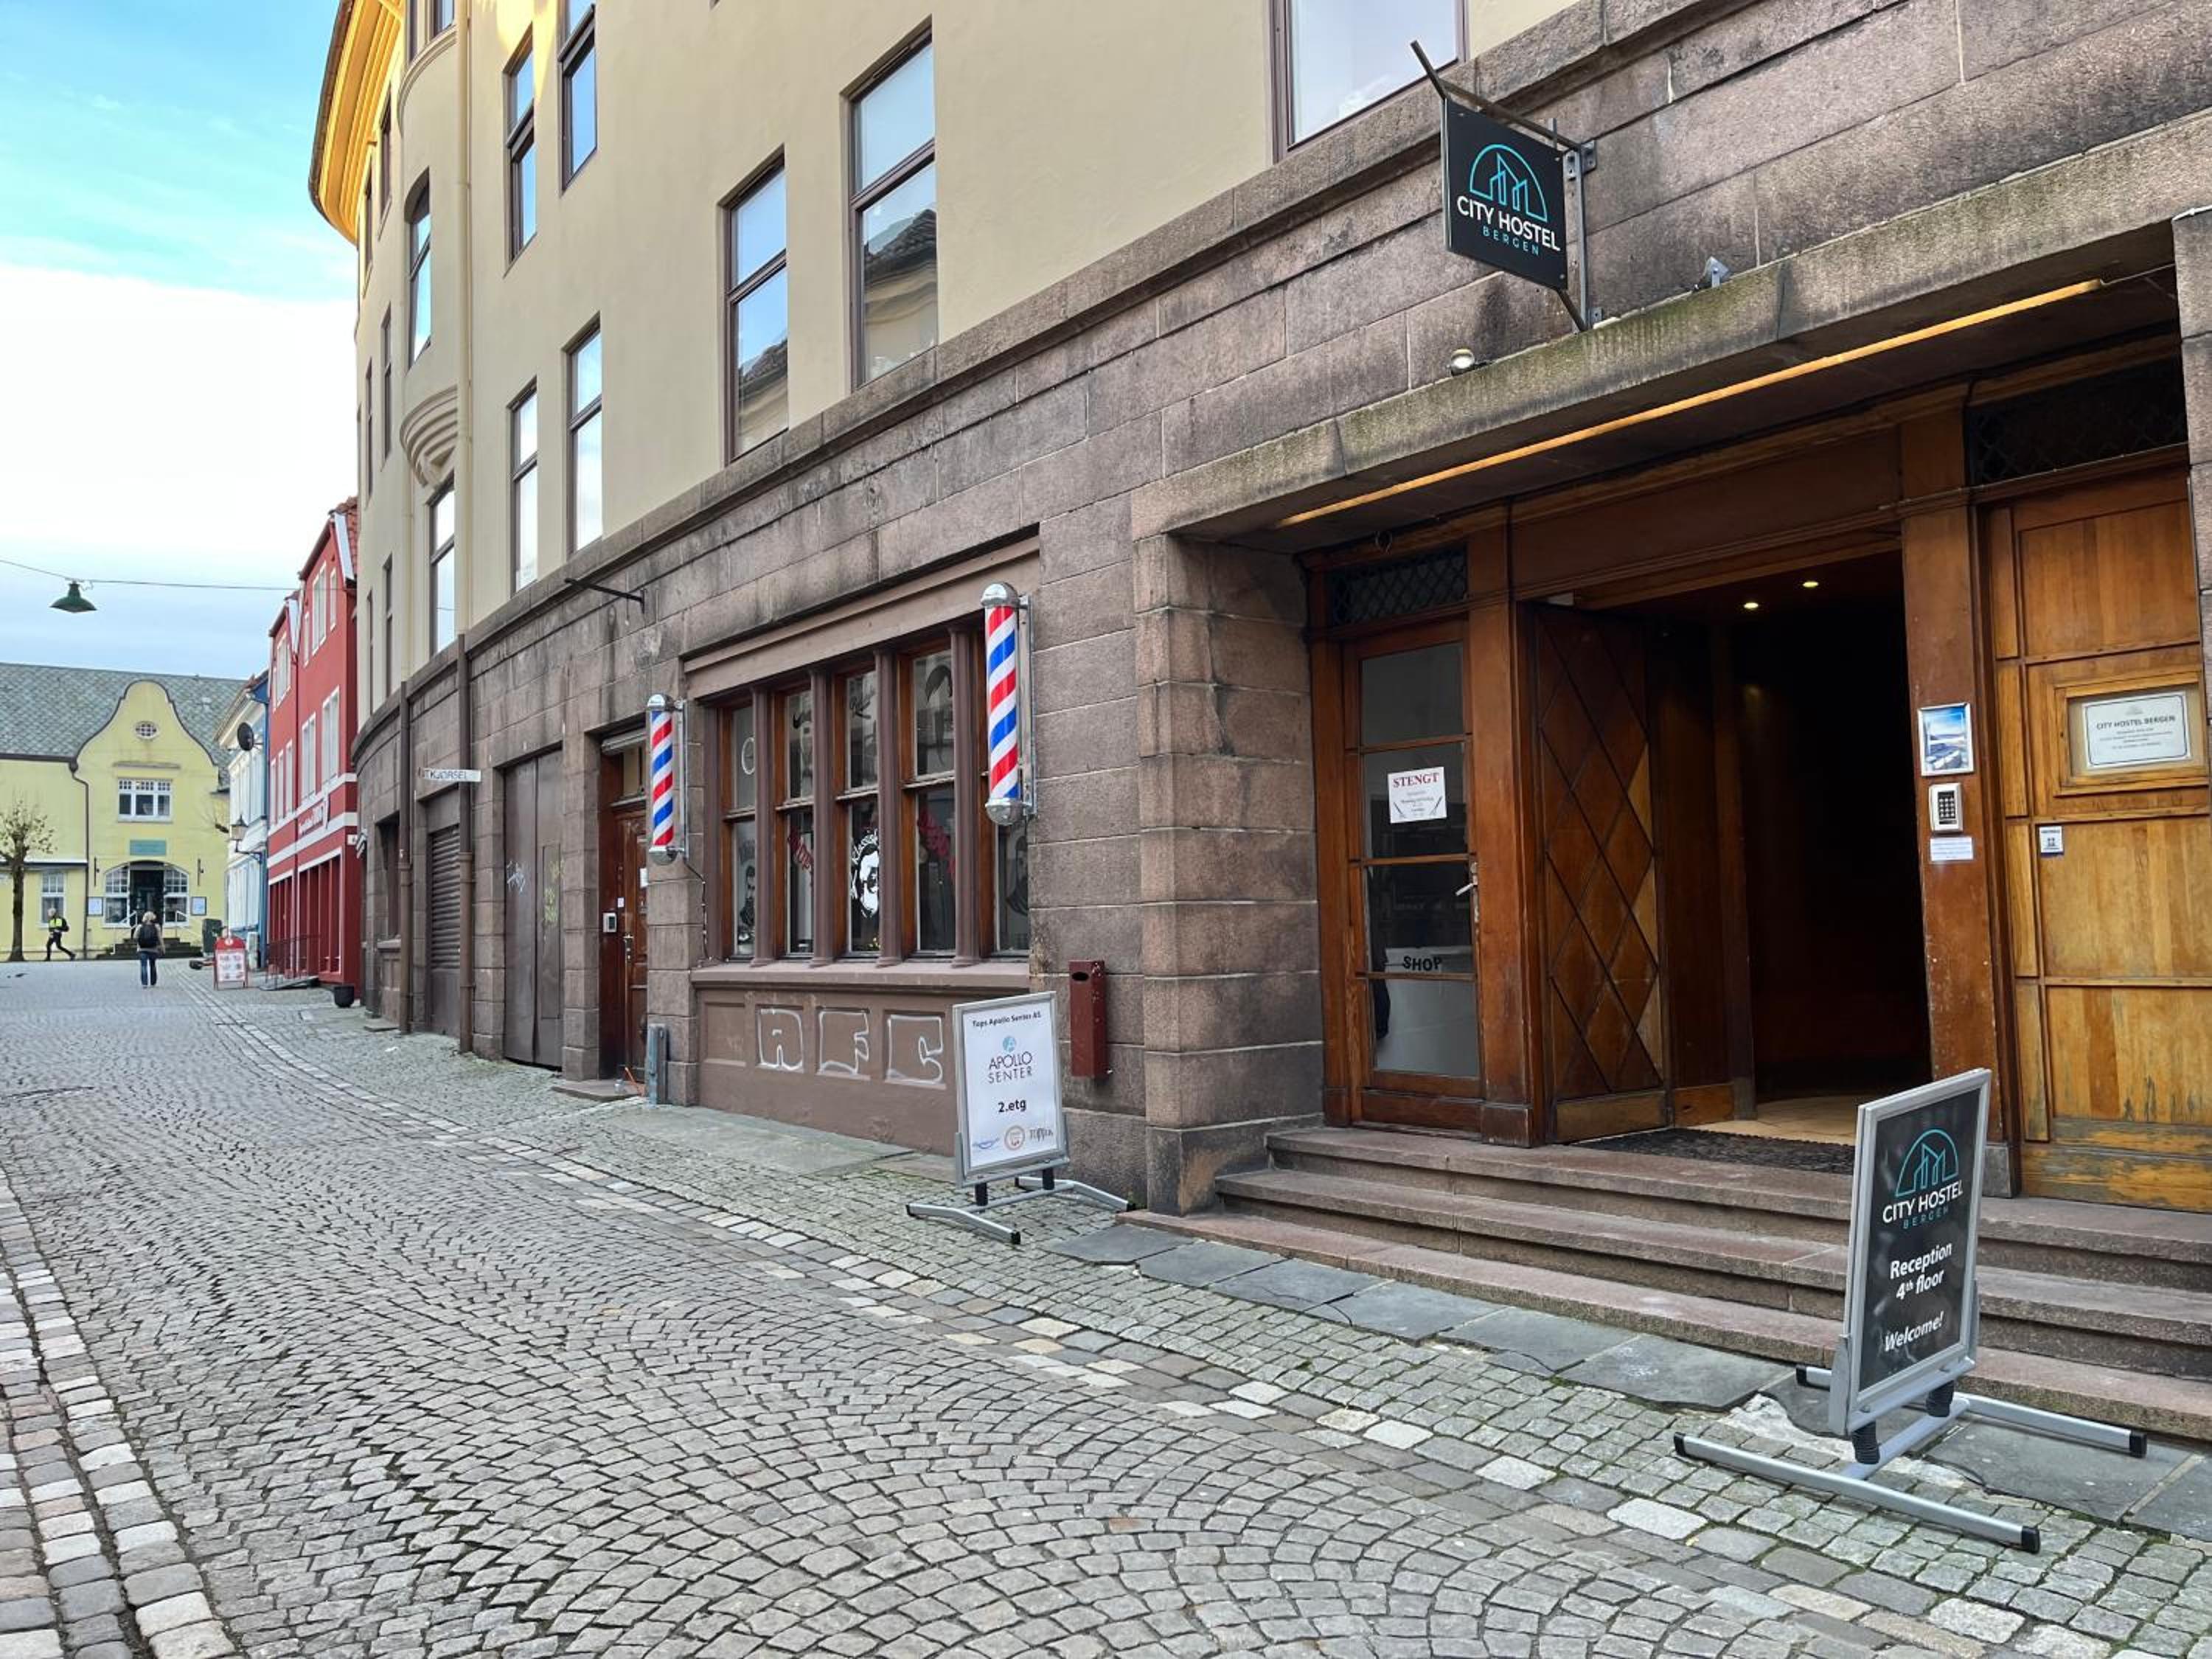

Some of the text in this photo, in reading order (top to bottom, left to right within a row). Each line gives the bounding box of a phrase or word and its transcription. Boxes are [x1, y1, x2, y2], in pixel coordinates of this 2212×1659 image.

[1456, 195, 1561, 251] CITY HOSTEL
[1483, 226, 1540, 257] BERGEN
[2096, 722, 2112, 730] CITY
[1393, 772, 1440, 788] STENGT
[1402, 955, 1441, 972] SHOP
[989, 1051, 1033, 1071] APOLLO
[988, 1065, 1033, 1084] SENTER
[998, 1099, 1027, 1114] 2.etg
[1882, 1180, 1964, 1225] CITY HOSTEL
[1903, 1206, 1950, 1230] BERGEN
[1889, 1242, 1952, 1280] Reception
[1896, 1268, 1945, 1301] 4th floor
[1884, 1311, 1945, 1352] Welcome!
